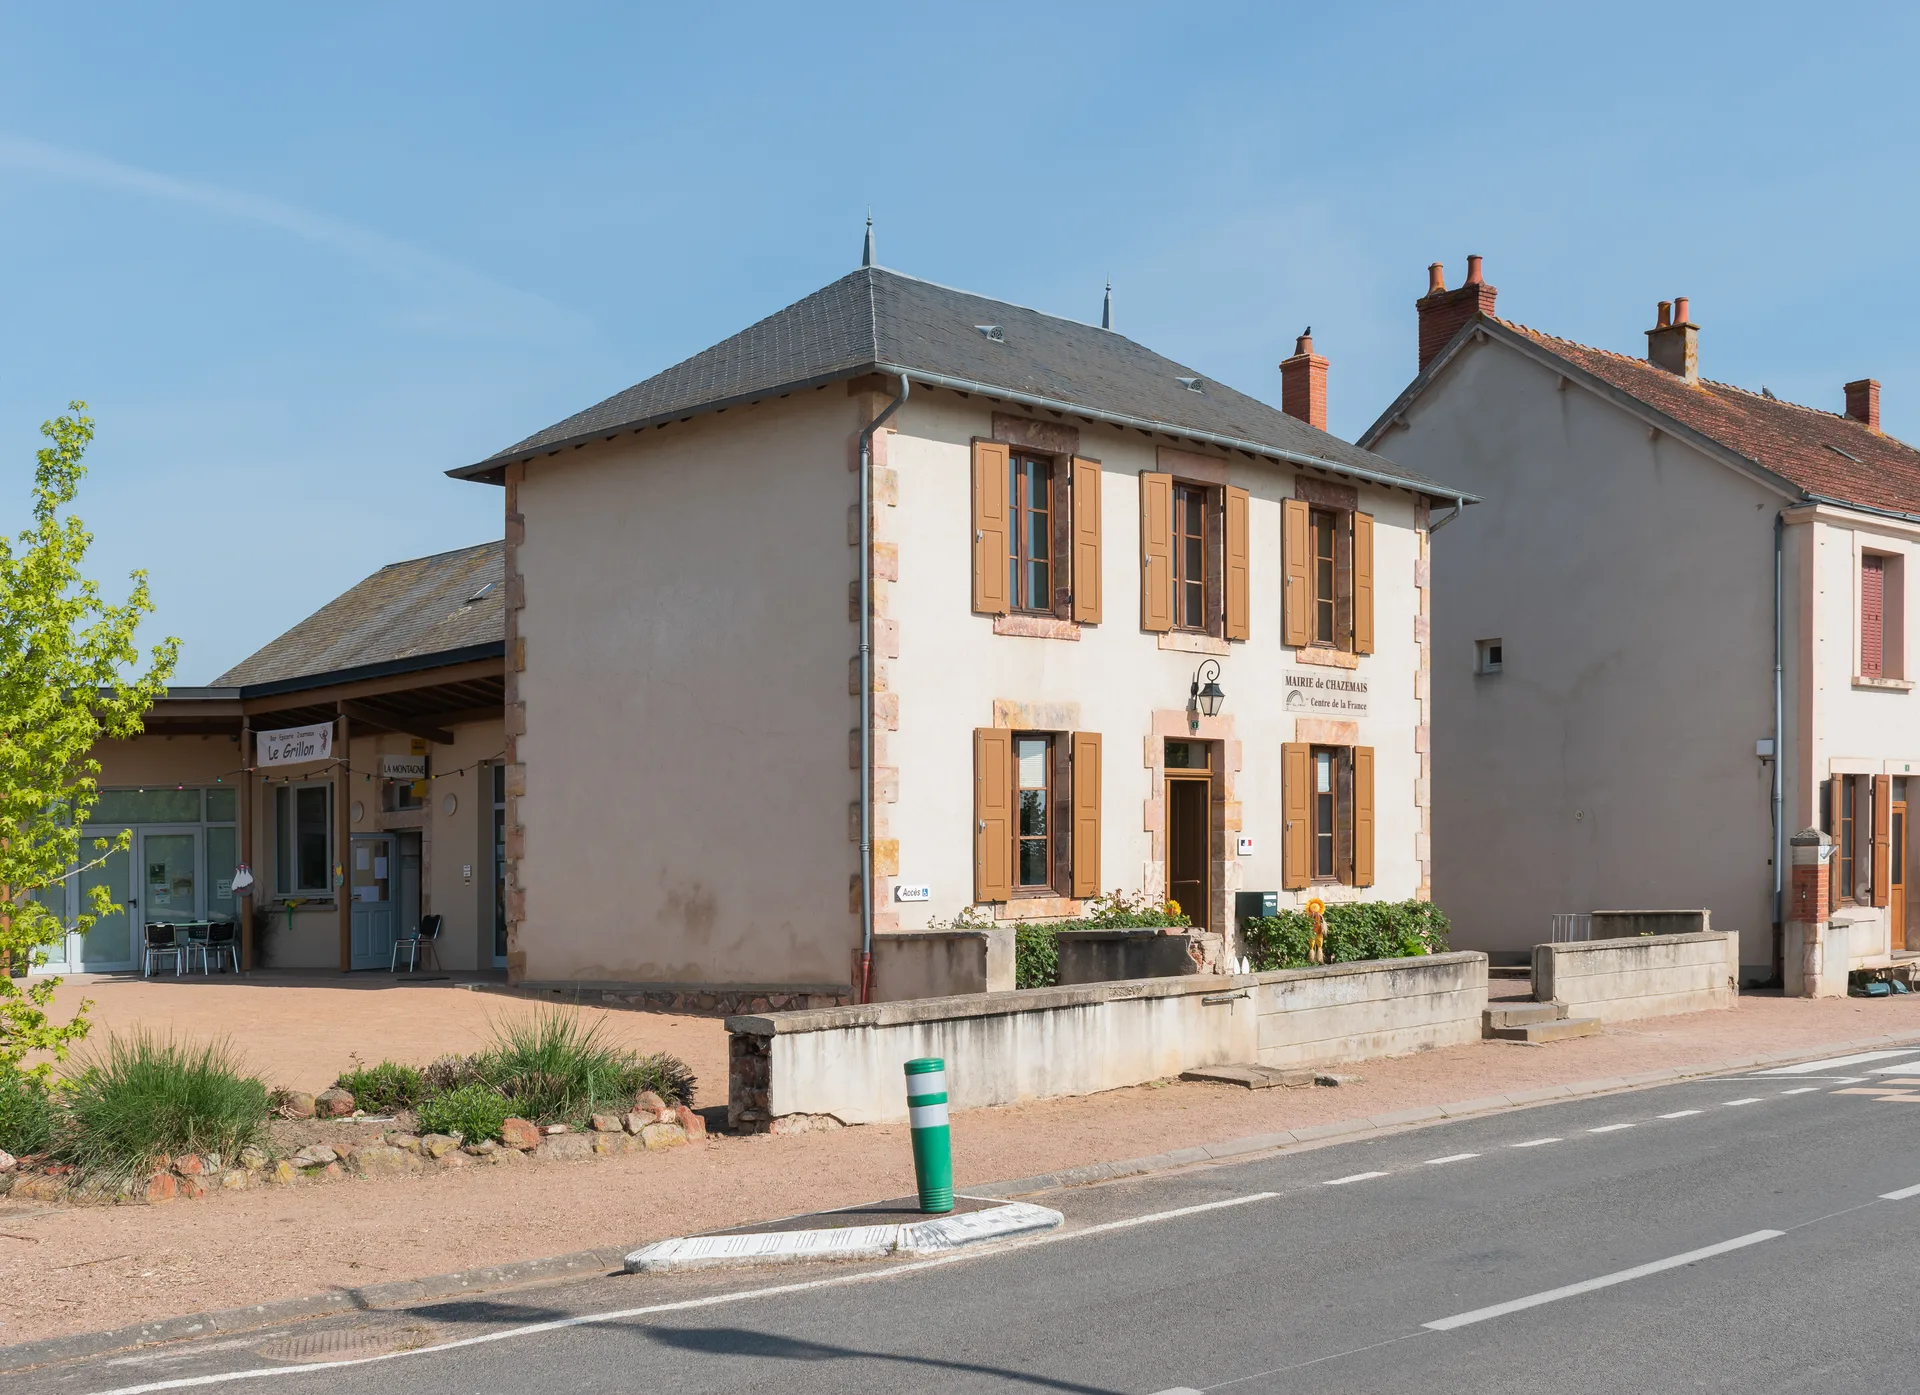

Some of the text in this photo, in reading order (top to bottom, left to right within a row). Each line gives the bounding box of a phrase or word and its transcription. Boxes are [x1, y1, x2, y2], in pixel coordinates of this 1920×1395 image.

[1285, 676, 1368, 693] MAIRIE de CHAZEMAIS
[1310, 697, 1330, 708] Centre
[1332, 699, 1339, 708] de
[1340, 699, 1346, 709] la
[1347, 700, 1367, 710] France
[268, 741, 315, 761] Le Grillon
[384, 764, 425, 775] LA MONTAGNE
[902, 887, 921, 897] Accès
